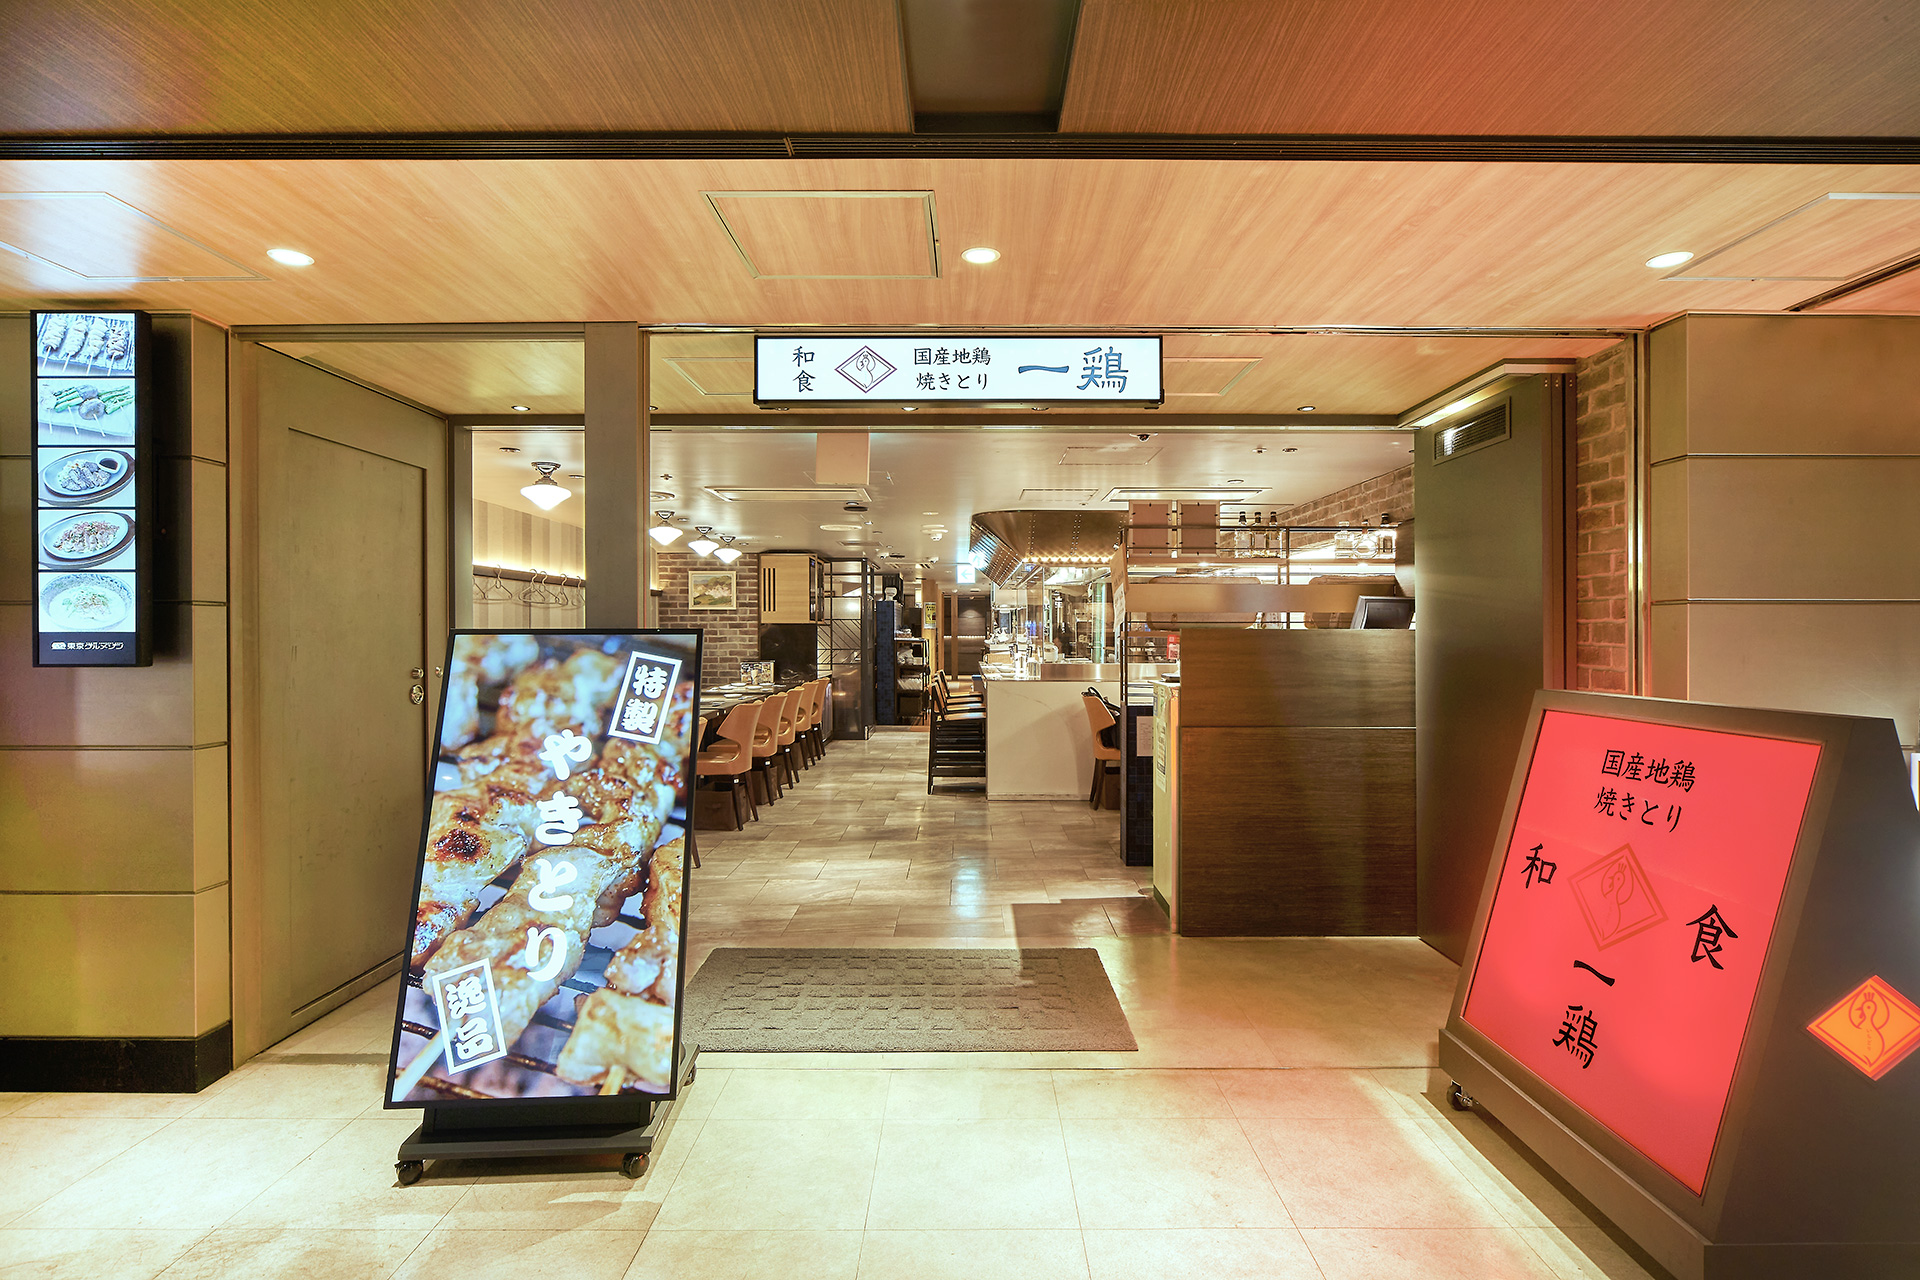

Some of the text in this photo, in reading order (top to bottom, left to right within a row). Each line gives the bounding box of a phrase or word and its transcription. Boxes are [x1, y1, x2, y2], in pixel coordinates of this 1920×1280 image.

[793, 346, 815, 392] 和食
[914, 347, 990, 366] 国産地鶏
[1018, 346, 1128, 394] 一鶏
[917, 372, 987, 391] 焼きとり
[621, 664, 668, 735] 特製
[1600, 749, 1696, 794] 国産地鶏
[1594, 786, 1683, 833] 焼きとり
[525, 728, 592, 982] やきとり
[444, 976, 494, 1060] 逸品
[1552, 960, 1615, 1069] 一鶏
